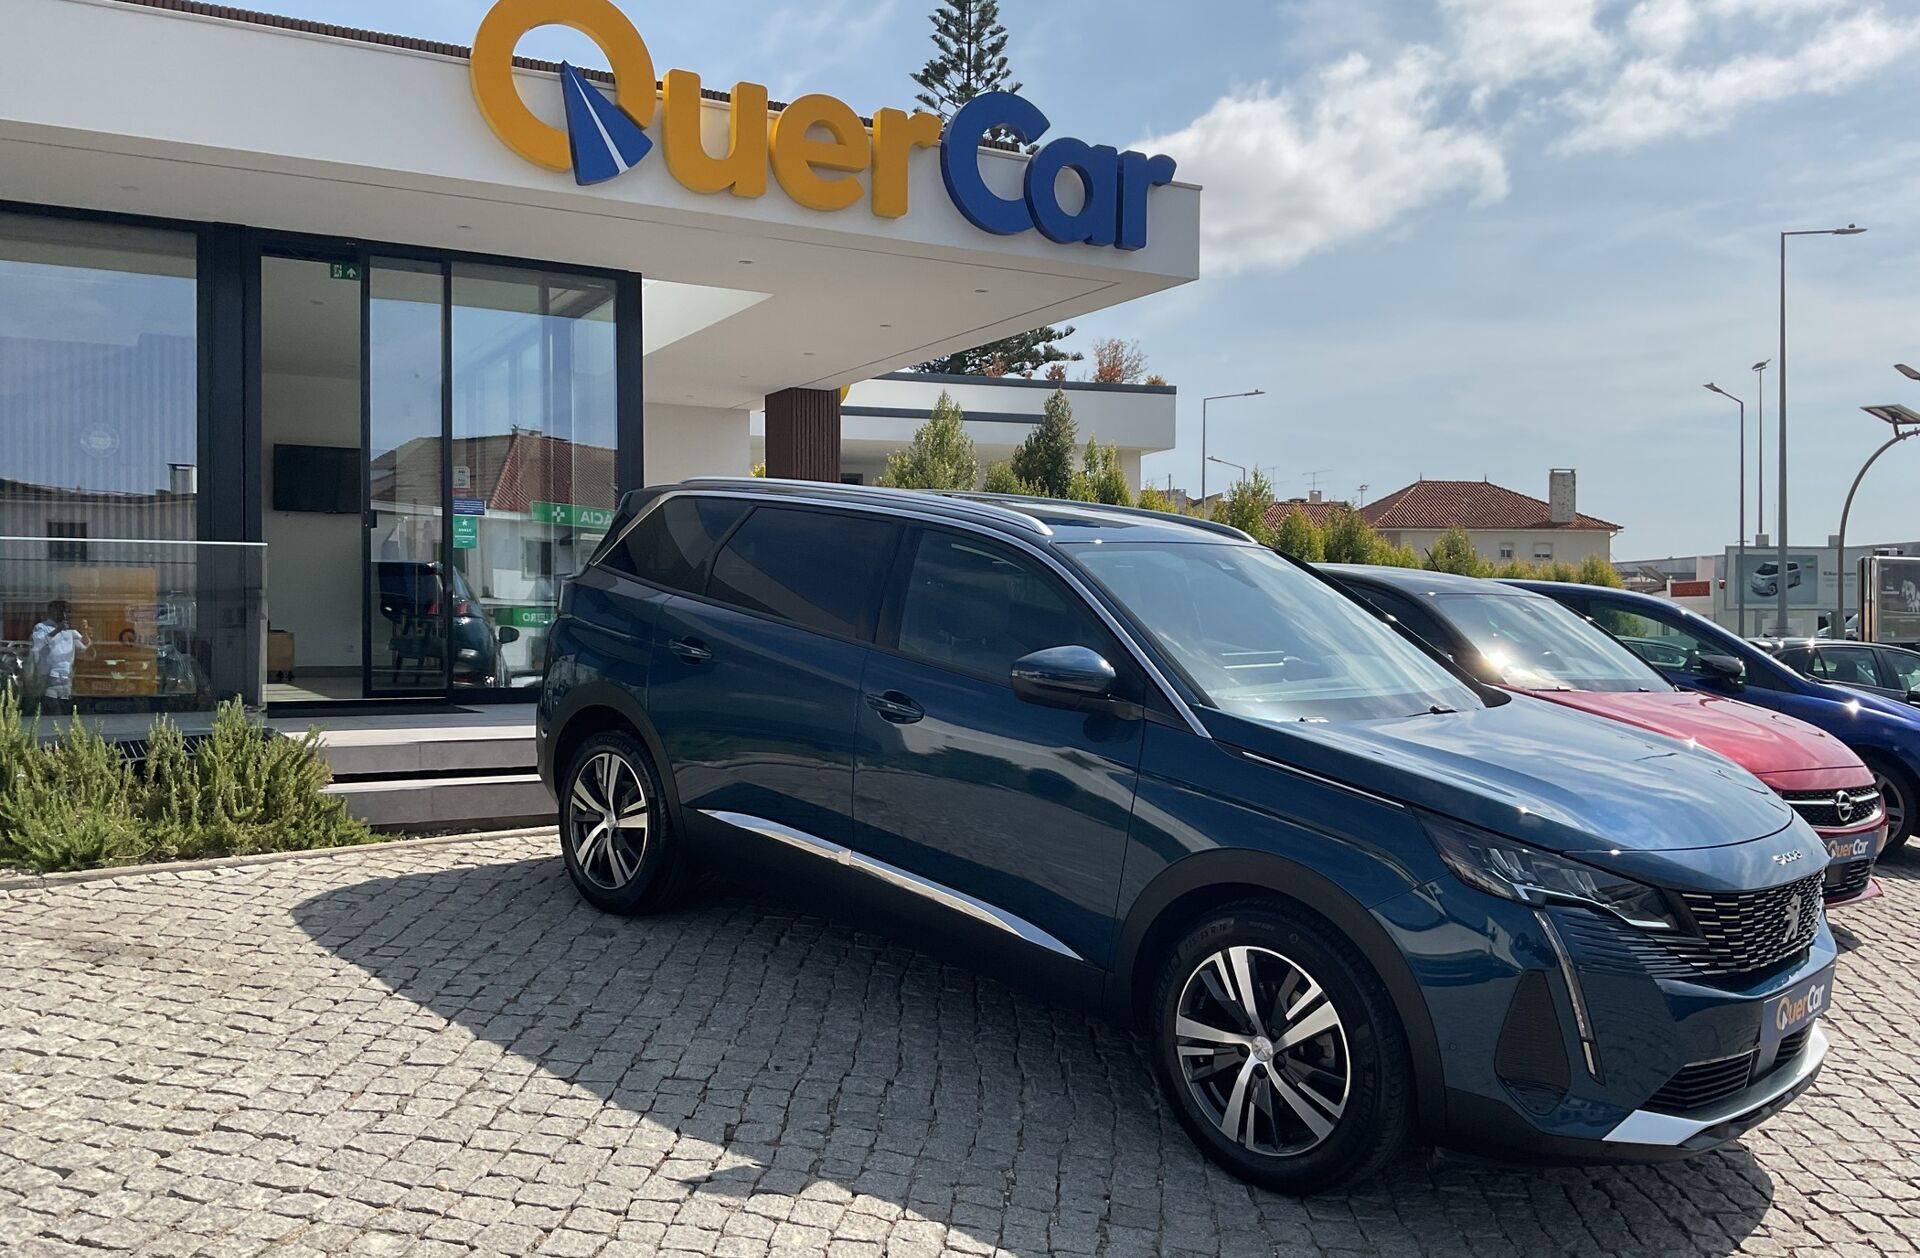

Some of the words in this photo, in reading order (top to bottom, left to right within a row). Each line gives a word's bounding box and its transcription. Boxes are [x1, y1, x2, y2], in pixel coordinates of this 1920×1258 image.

[469, 0, 1177, 251] QuerCar
[1772, 849, 1803, 866] 5008
[1827, 838, 1869, 859] QuerCar
[1775, 984, 1825, 1031] QuerCar
